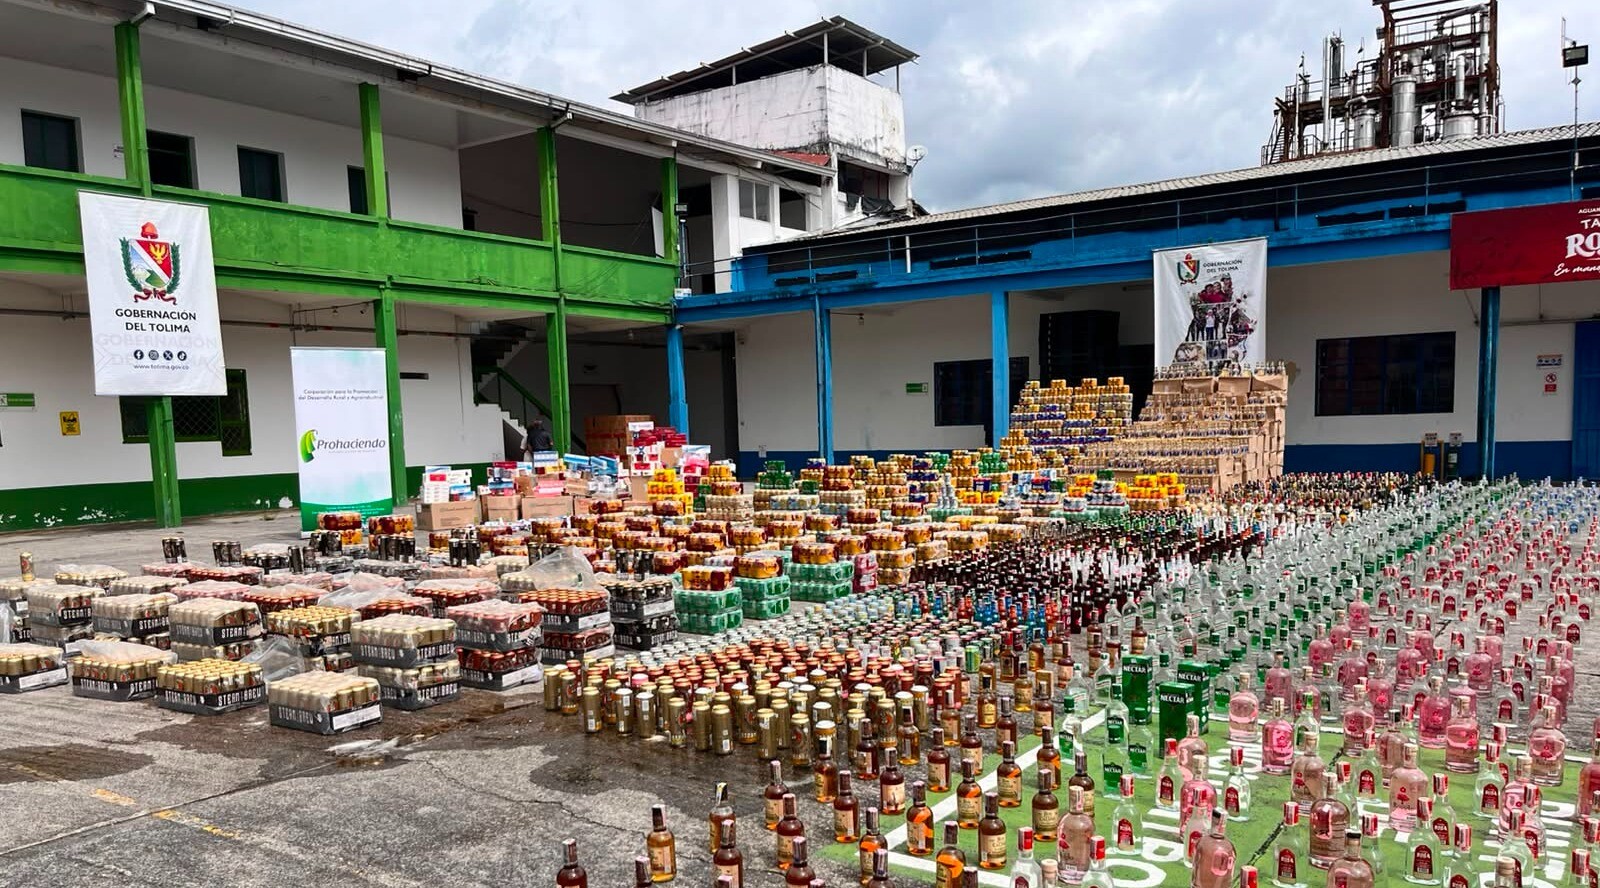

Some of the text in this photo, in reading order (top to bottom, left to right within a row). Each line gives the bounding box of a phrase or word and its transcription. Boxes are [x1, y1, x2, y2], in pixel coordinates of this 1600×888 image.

[115, 307, 197, 321] GOBERNACIÓN
[125, 321, 191, 334] DEL TOLIMA
[316, 438, 386, 450] Prohaciendo
[1123, 664, 1147, 674] NECTAR
[1178, 673, 1202, 682] NECTAR
[218, 691, 240, 706] STEAM
[1160, 694, 1185, 703] NECTAR
